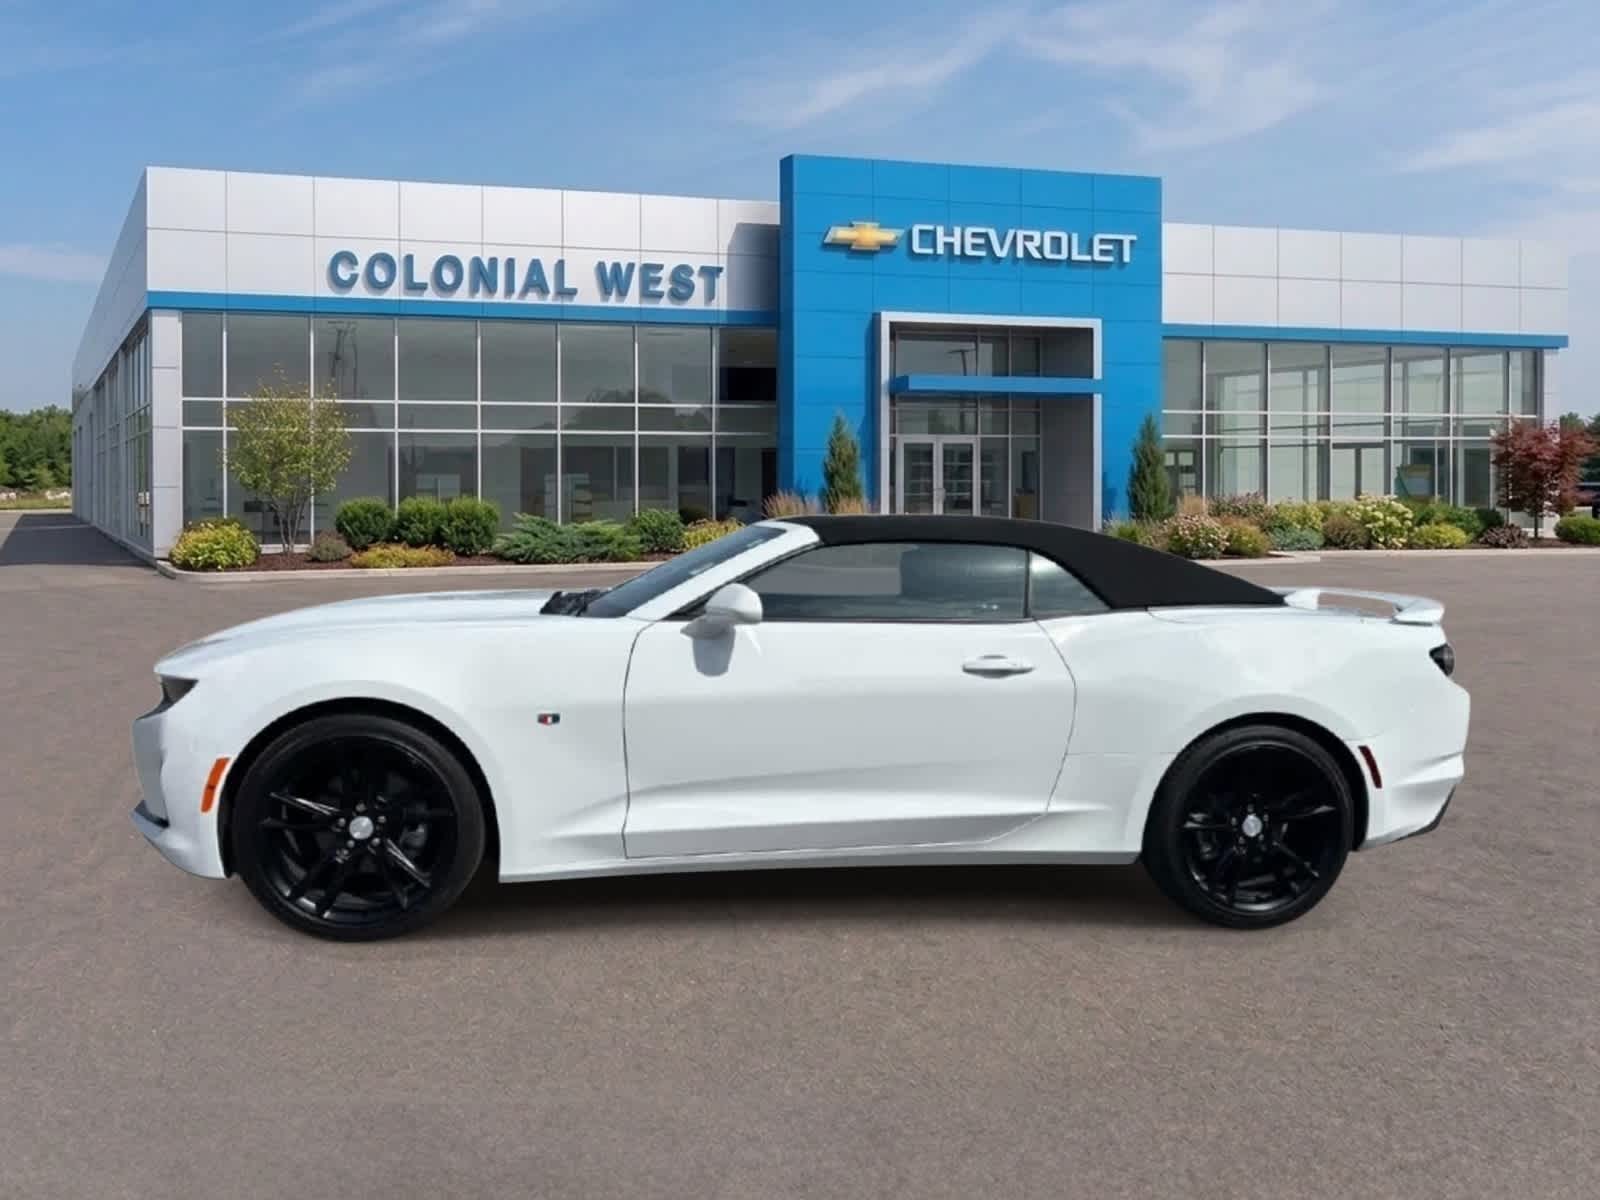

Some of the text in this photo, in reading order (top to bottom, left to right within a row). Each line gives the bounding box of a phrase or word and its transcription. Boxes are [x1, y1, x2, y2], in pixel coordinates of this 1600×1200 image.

[911, 224, 1138, 264] CHEVROLET
[328, 250, 724, 302] COLONIAL WEST
